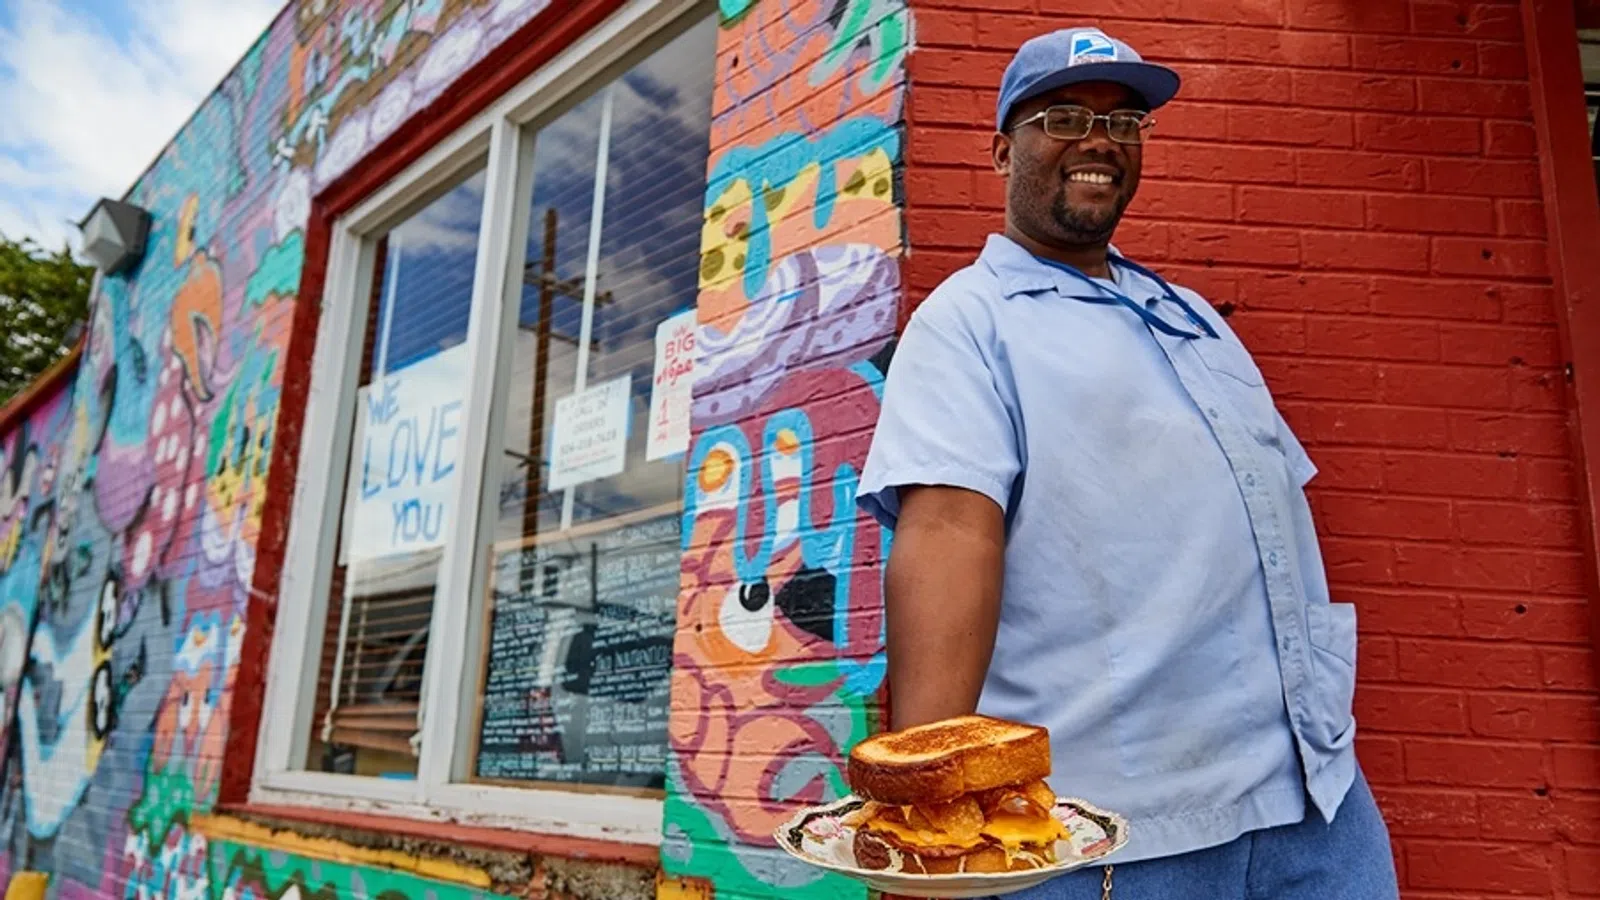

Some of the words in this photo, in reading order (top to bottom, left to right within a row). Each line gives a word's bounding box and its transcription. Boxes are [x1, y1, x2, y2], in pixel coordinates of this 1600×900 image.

[665, 332, 695, 360] BIG
[367, 379, 400, 425] WE
[362, 400, 463, 501] LOVE
[391, 498, 444, 545] YOU
